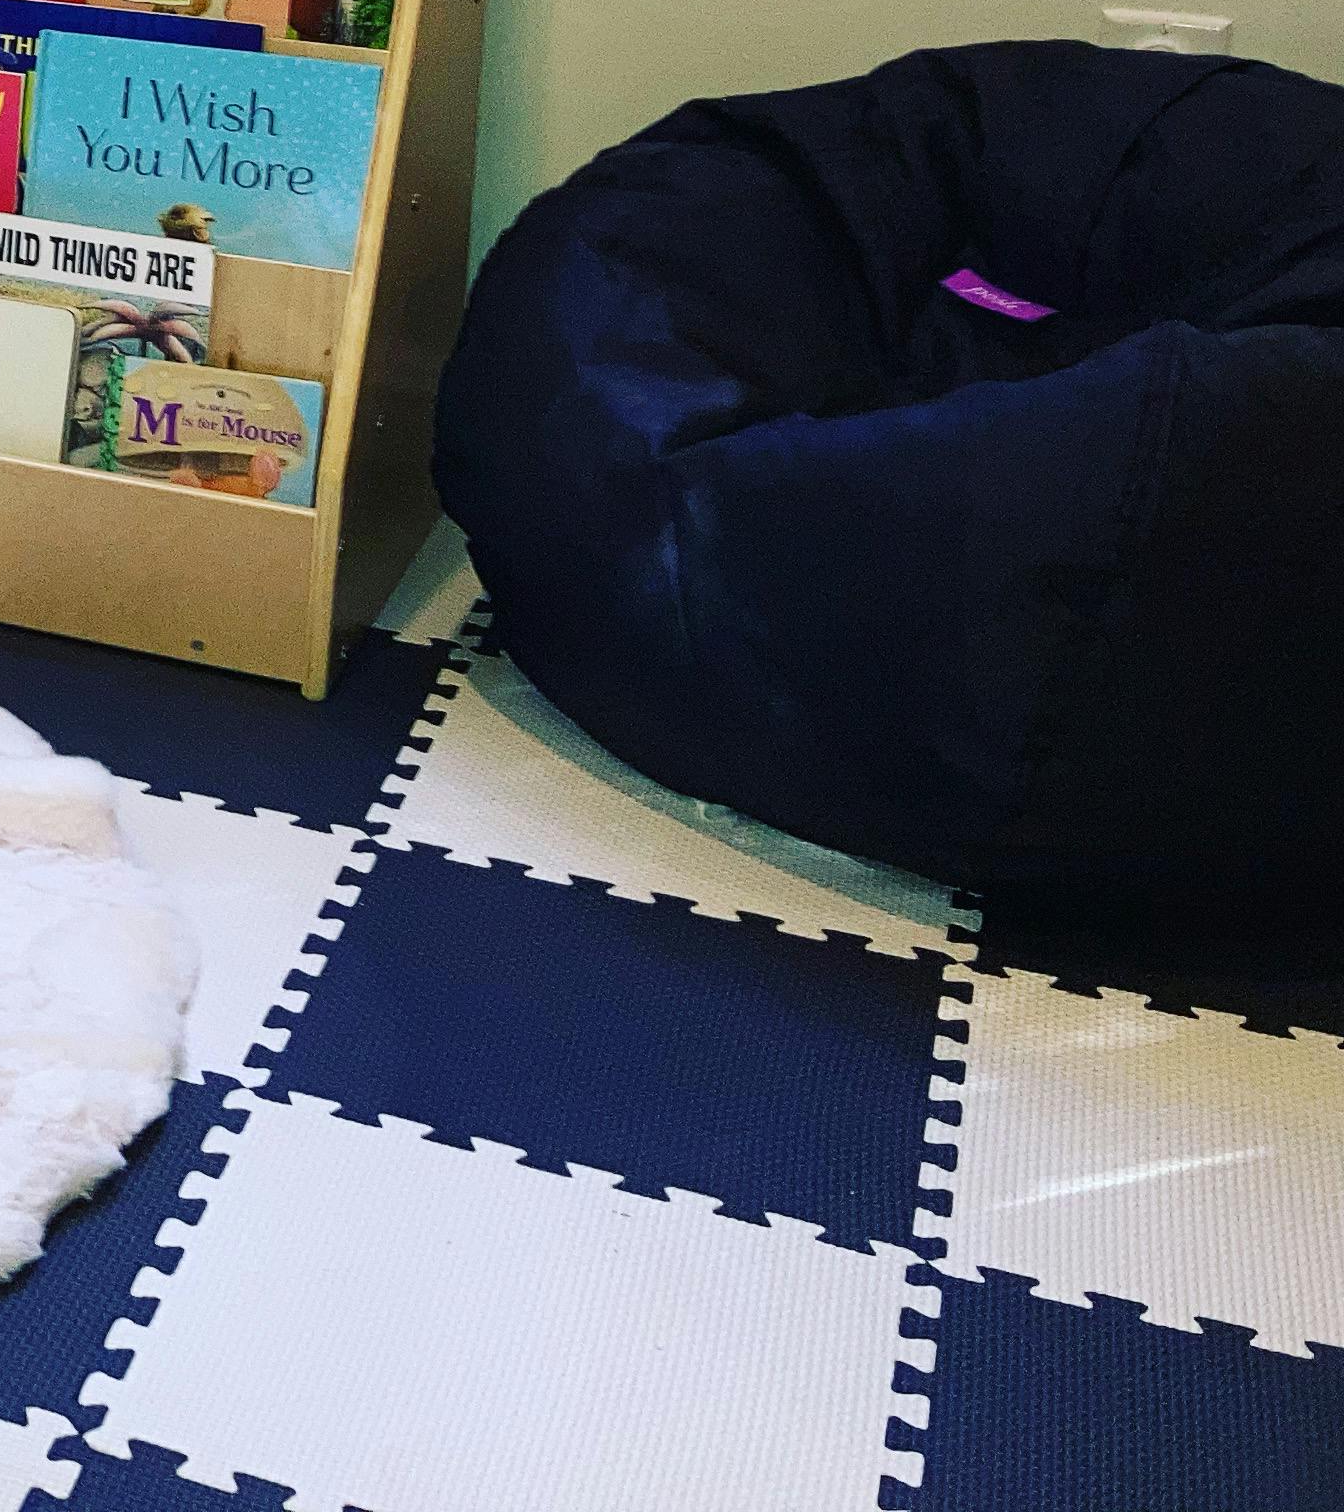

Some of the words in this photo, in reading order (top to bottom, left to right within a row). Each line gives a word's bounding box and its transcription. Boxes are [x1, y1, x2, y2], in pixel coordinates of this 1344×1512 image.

[120, 76, 132, 120] I
[149, 79, 278, 136] Wish
[76, 124, 164, 180] You
[181, 138, 315, 196] More
[49, 236, 138, 283] THINGS
[144, 250, 196, 293] ARE
[128, 396, 184, 446] M
[182, 415, 194, 427] is
[220, 415, 302, 449] Mouse
